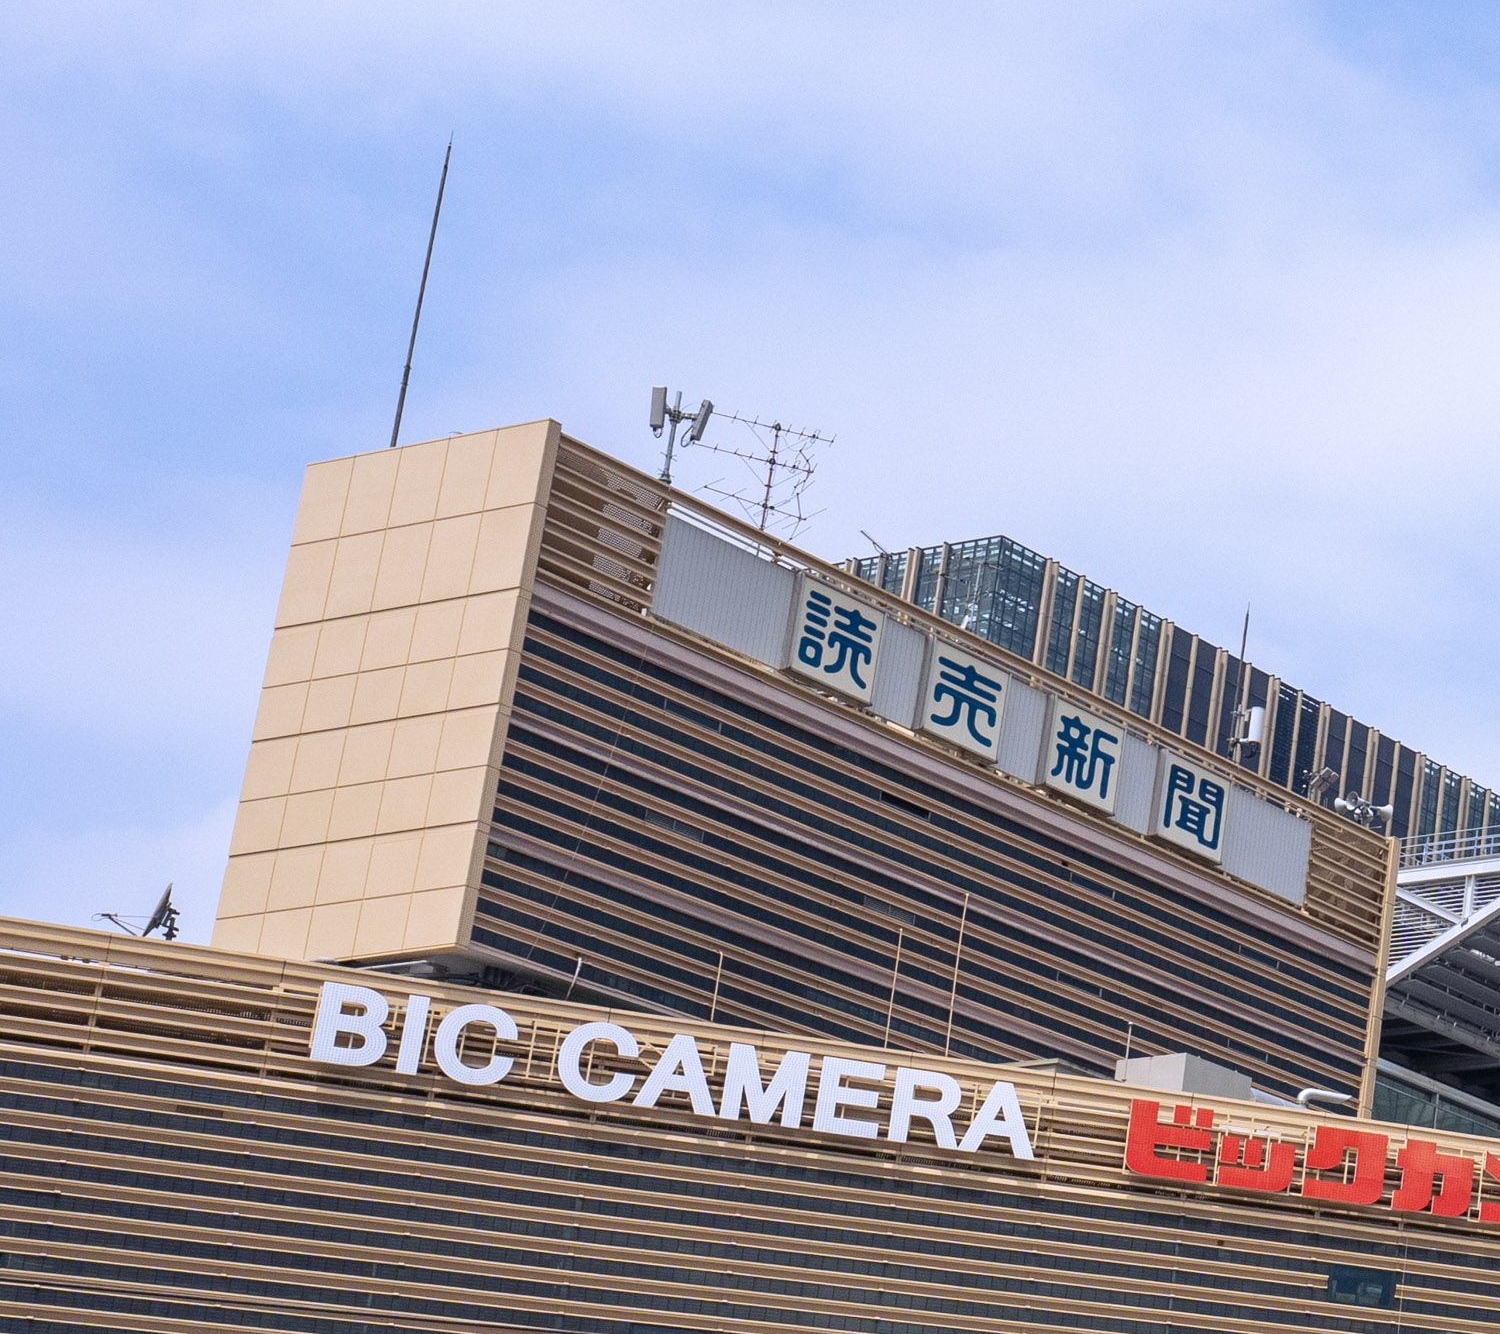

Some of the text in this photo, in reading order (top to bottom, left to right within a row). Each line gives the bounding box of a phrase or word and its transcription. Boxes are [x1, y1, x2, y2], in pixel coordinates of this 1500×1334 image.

[797, 588, 1226, 851] 読売新聞
[308, 981, 1035, 1160] BIC CAMERA
